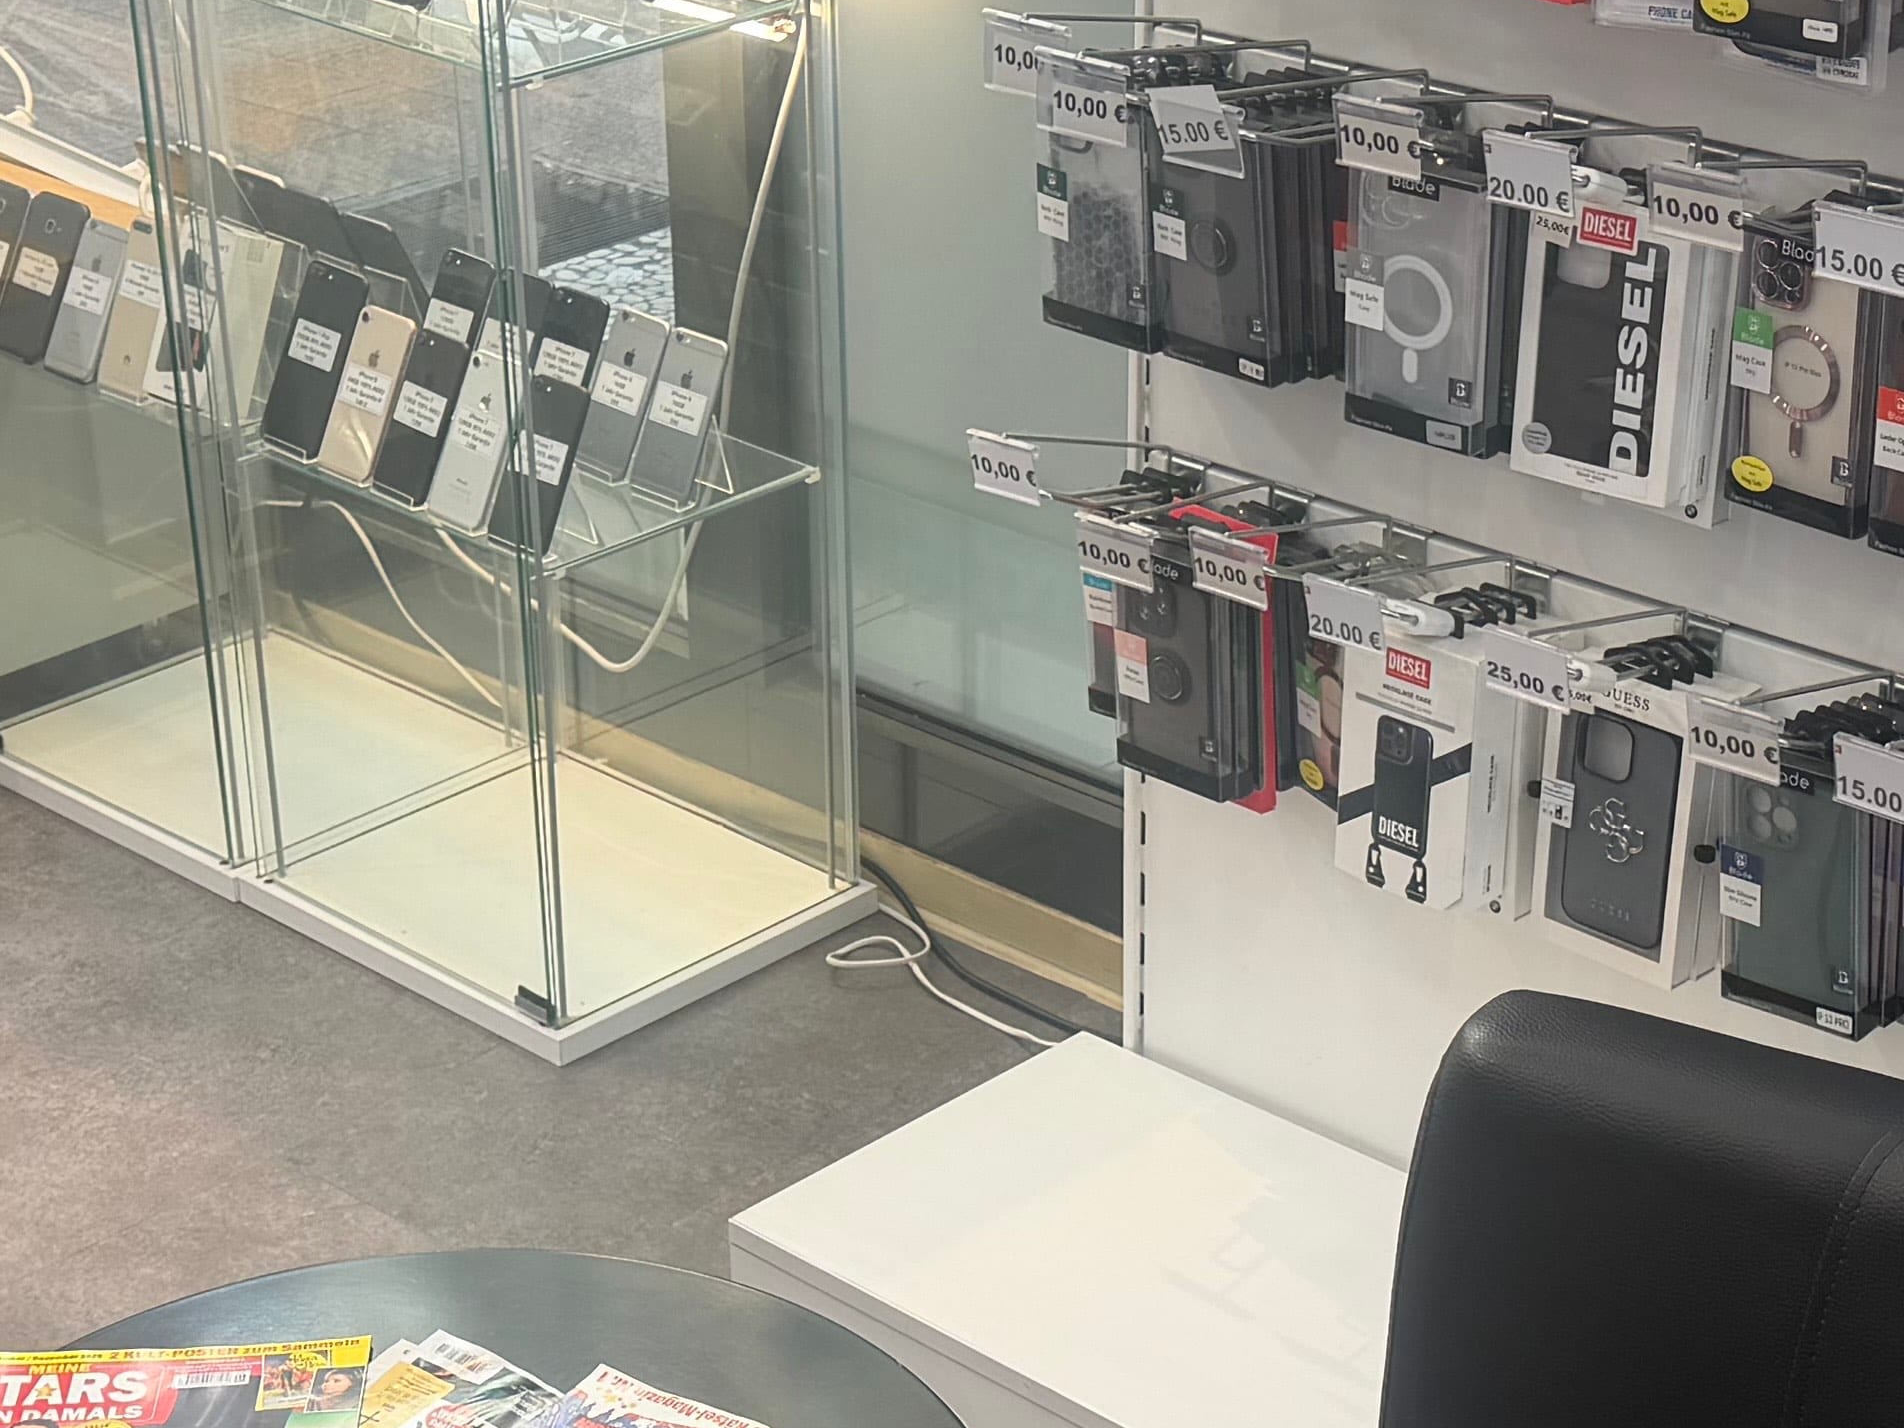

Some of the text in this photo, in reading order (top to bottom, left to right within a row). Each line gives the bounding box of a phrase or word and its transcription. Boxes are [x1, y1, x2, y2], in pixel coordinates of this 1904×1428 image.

[1159, 120, 1228, 144] 15.00 €
[1490, 177, 1570, 212] 20.00 €
[1584, 211, 1632, 244] DIESEL
[1816, 244, 1883, 280] 15.00
[1612, 247, 1656, 476] DIESEL
[971, 454, 1036, 487] 10,00 €
[1079, 539, 1149, 574] 10,00 €
[1195, 557, 1265, 591] 10,00 €
[1311, 614, 1381, 649] 20.00 €
[1389, 653, 1428, 681] DIESEL
[1487, 661, 1564, 701] 25,00 €
[1690, 727, 1778, 764] 10,00 €
[1838, 776, 1902, 813] 15.00
[1379, 818, 1420, 847] DIESEL
[20, 1405, 143, 1422] DAMALS
